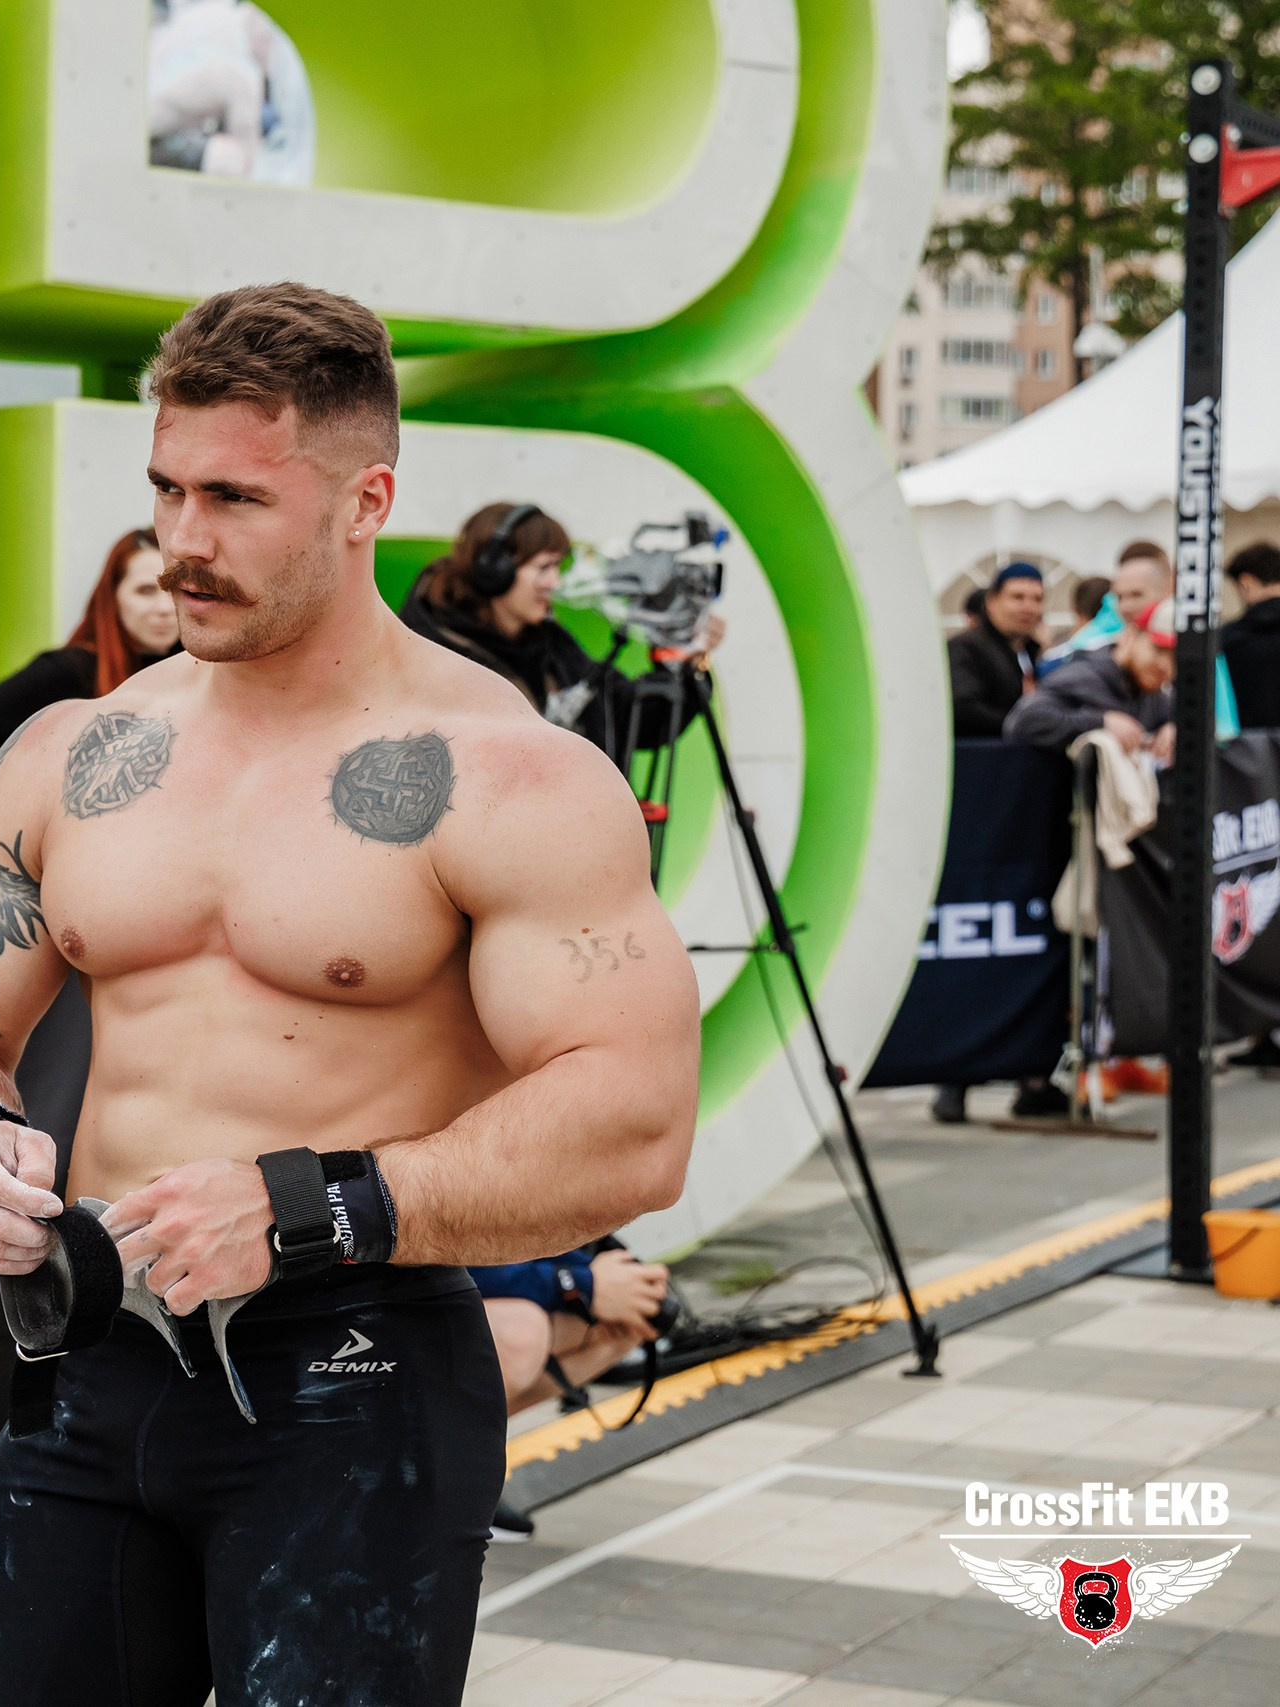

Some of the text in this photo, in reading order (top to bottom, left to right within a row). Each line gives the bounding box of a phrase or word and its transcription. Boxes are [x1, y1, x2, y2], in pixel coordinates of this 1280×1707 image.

[559, 931, 646, 984] 356
[326, 1183, 343, 1202] РА
[307, 1361, 398, 1373] DEMIX
